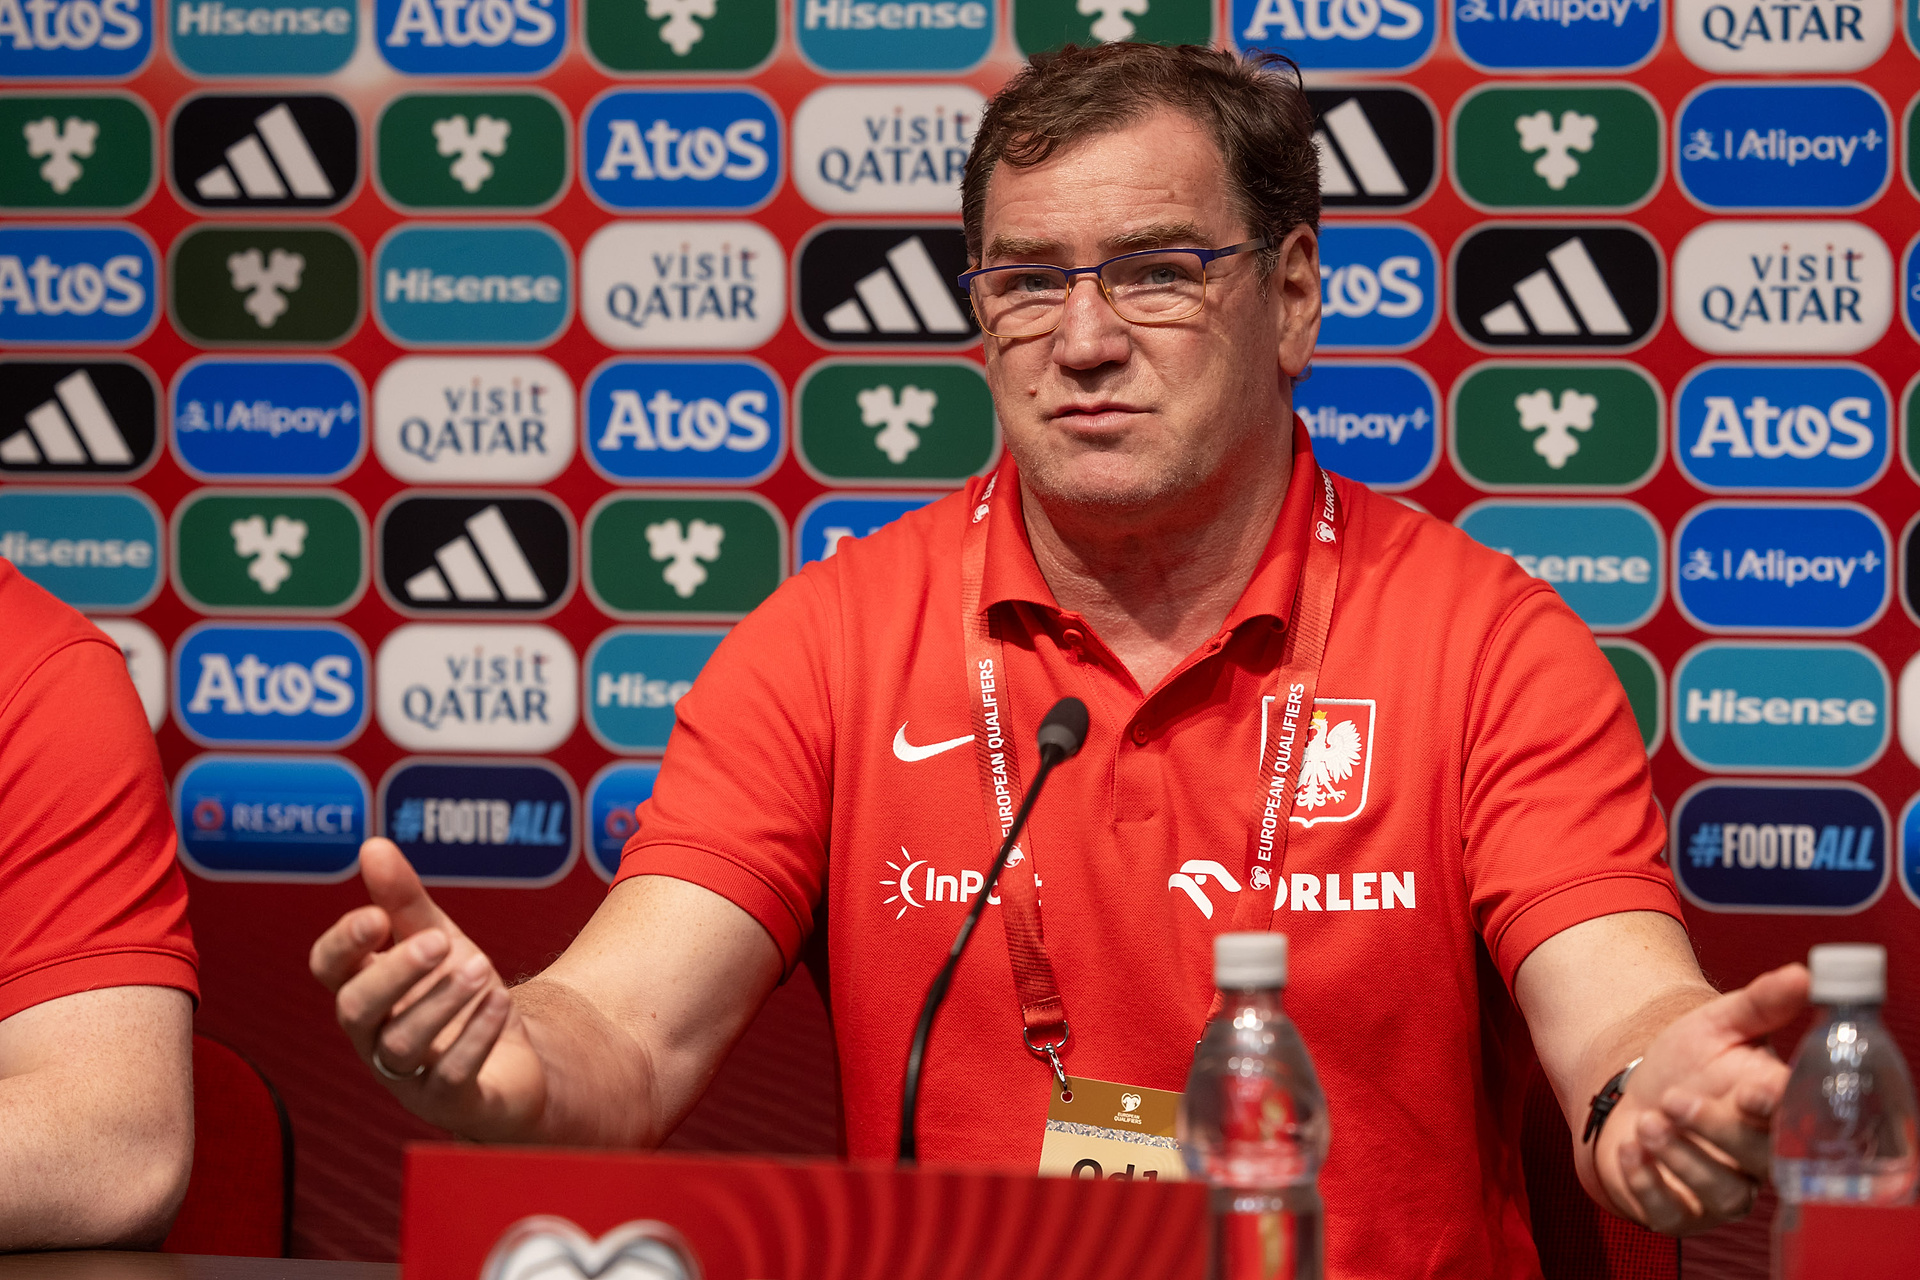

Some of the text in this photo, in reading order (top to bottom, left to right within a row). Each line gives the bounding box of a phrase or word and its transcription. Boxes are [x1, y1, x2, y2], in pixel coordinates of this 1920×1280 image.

[176, 2, 352, 35] Hisense
[803, 0, 987, 31] Hisense
[1701, 4, 1864, 50] QATAR
[864, 108, 971, 145] visit
[818, 147, 966, 193] QATAR
[652, 243, 757, 282] visit
[1751, 244, 1863, 283] visit
[385, 269, 562, 303] Hisense
[607, 283, 757, 328] QATAR
[1701, 286, 1863, 331] QATAR
[444, 377, 547, 416] visit
[399, 418, 548, 462] QATAR
[1492, 547, 1652, 584] sense
[447, 647, 548, 686] visit
[402, 686, 549, 731] QATAR
[978, 658, 1005, 750] QUALIFIERS
[1686, 689, 1877, 726] Hisense
[1257, 683, 1305, 862] EUROPEAN QUALIFIERS
[232, 803, 354, 834] RESPECT
[392, 799, 567, 846] #FOOTBALL
[1687, 823, 1876, 871] #FOOTBALL
